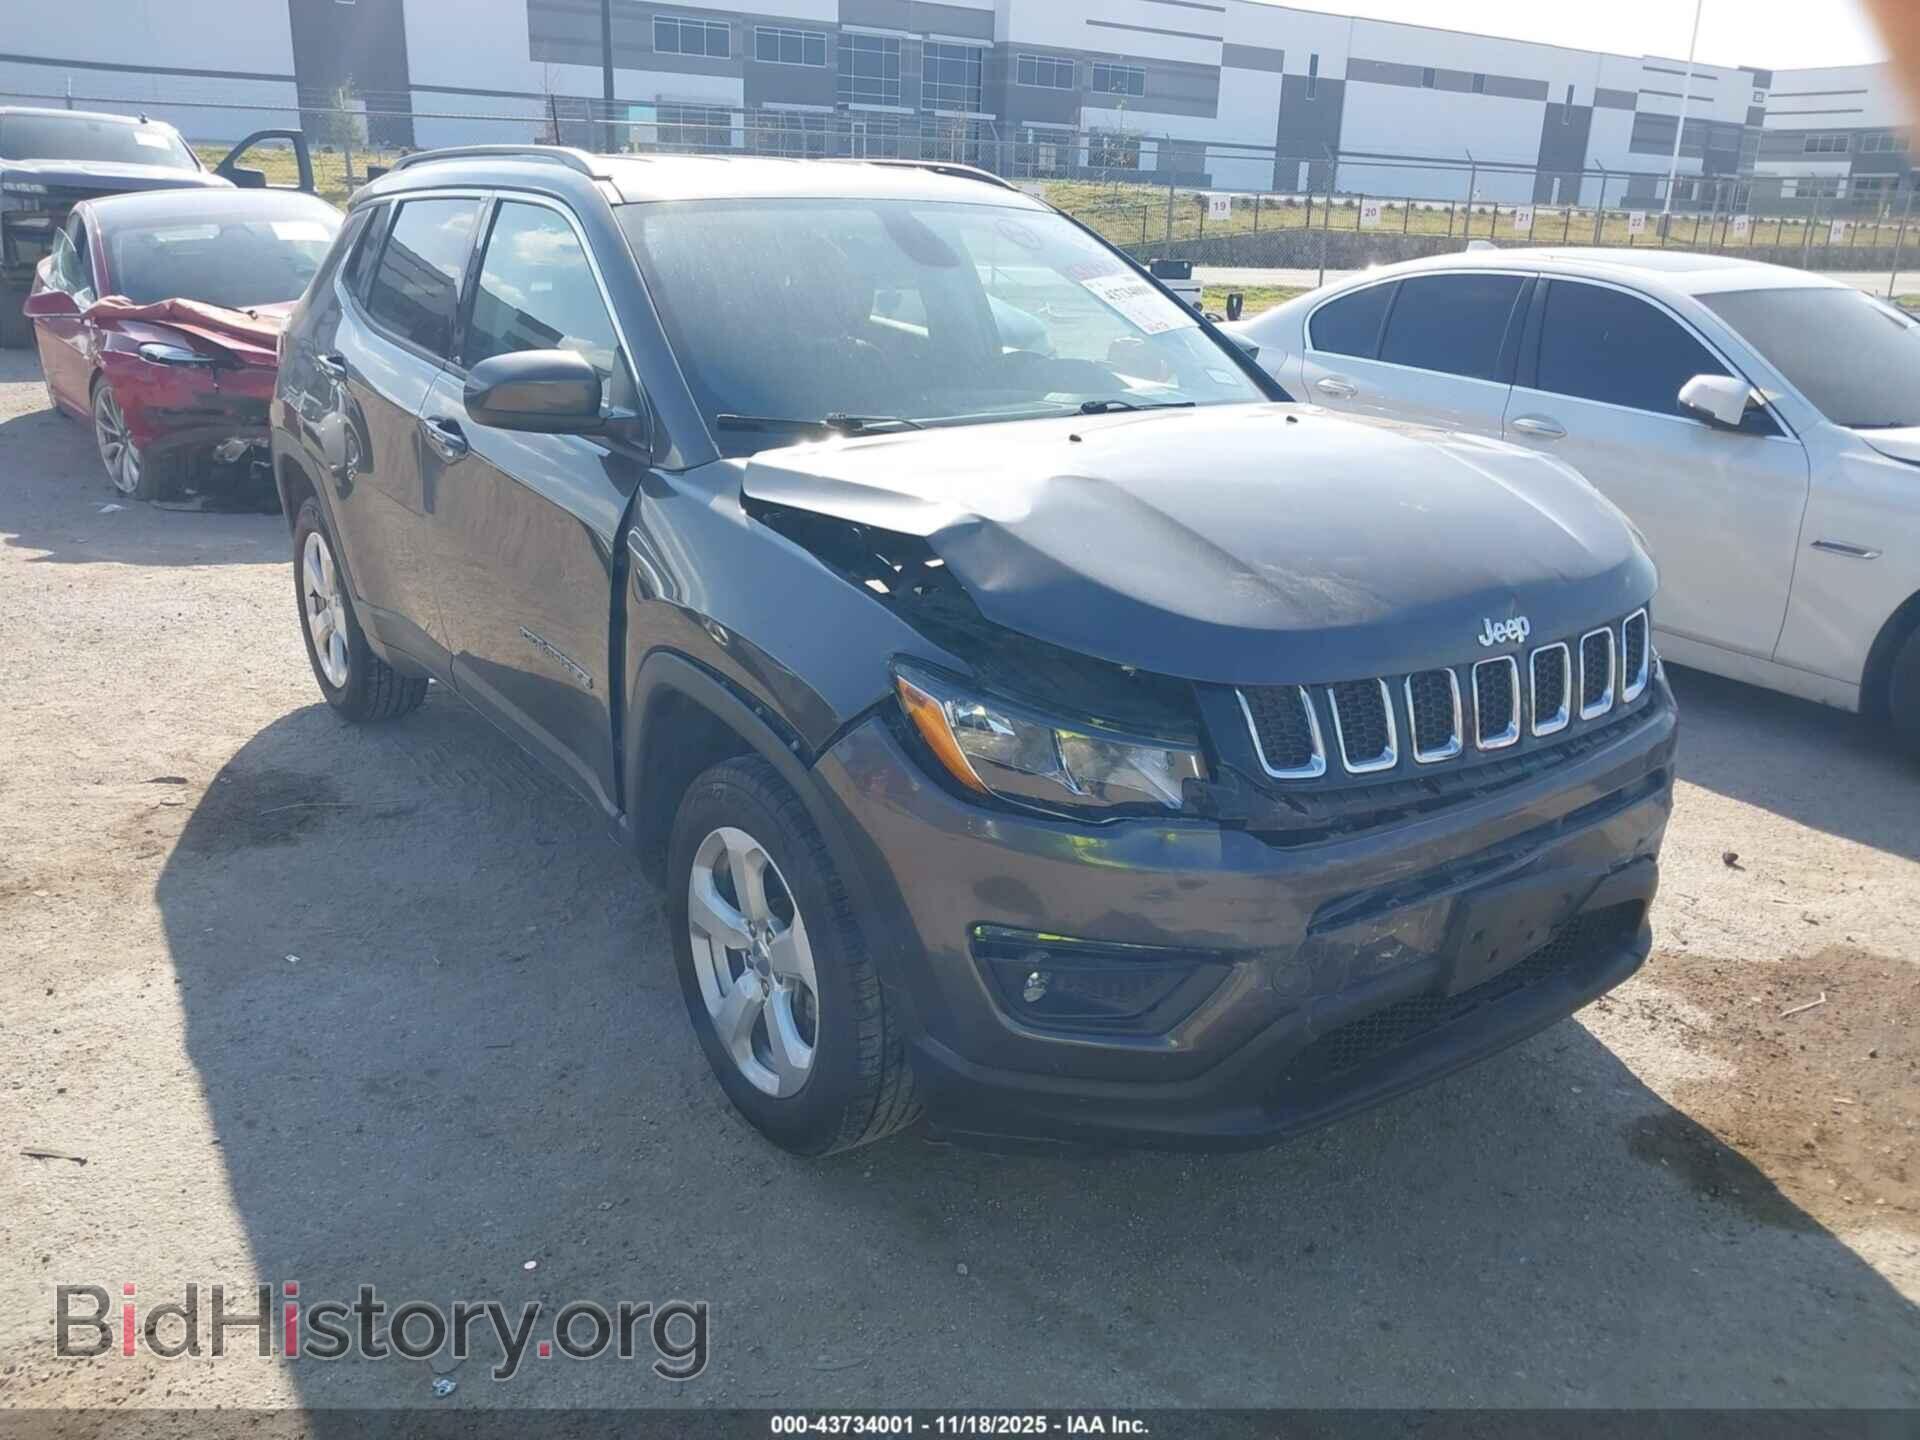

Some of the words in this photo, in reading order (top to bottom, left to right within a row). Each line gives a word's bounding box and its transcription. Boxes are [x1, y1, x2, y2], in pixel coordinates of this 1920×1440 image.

[1215, 201, 1226, 211] 19
[1364, 207, 1376, 217] 20
[1518, 212, 1529, 223] 21
[1478, 616, 1530, 646] Jeep
